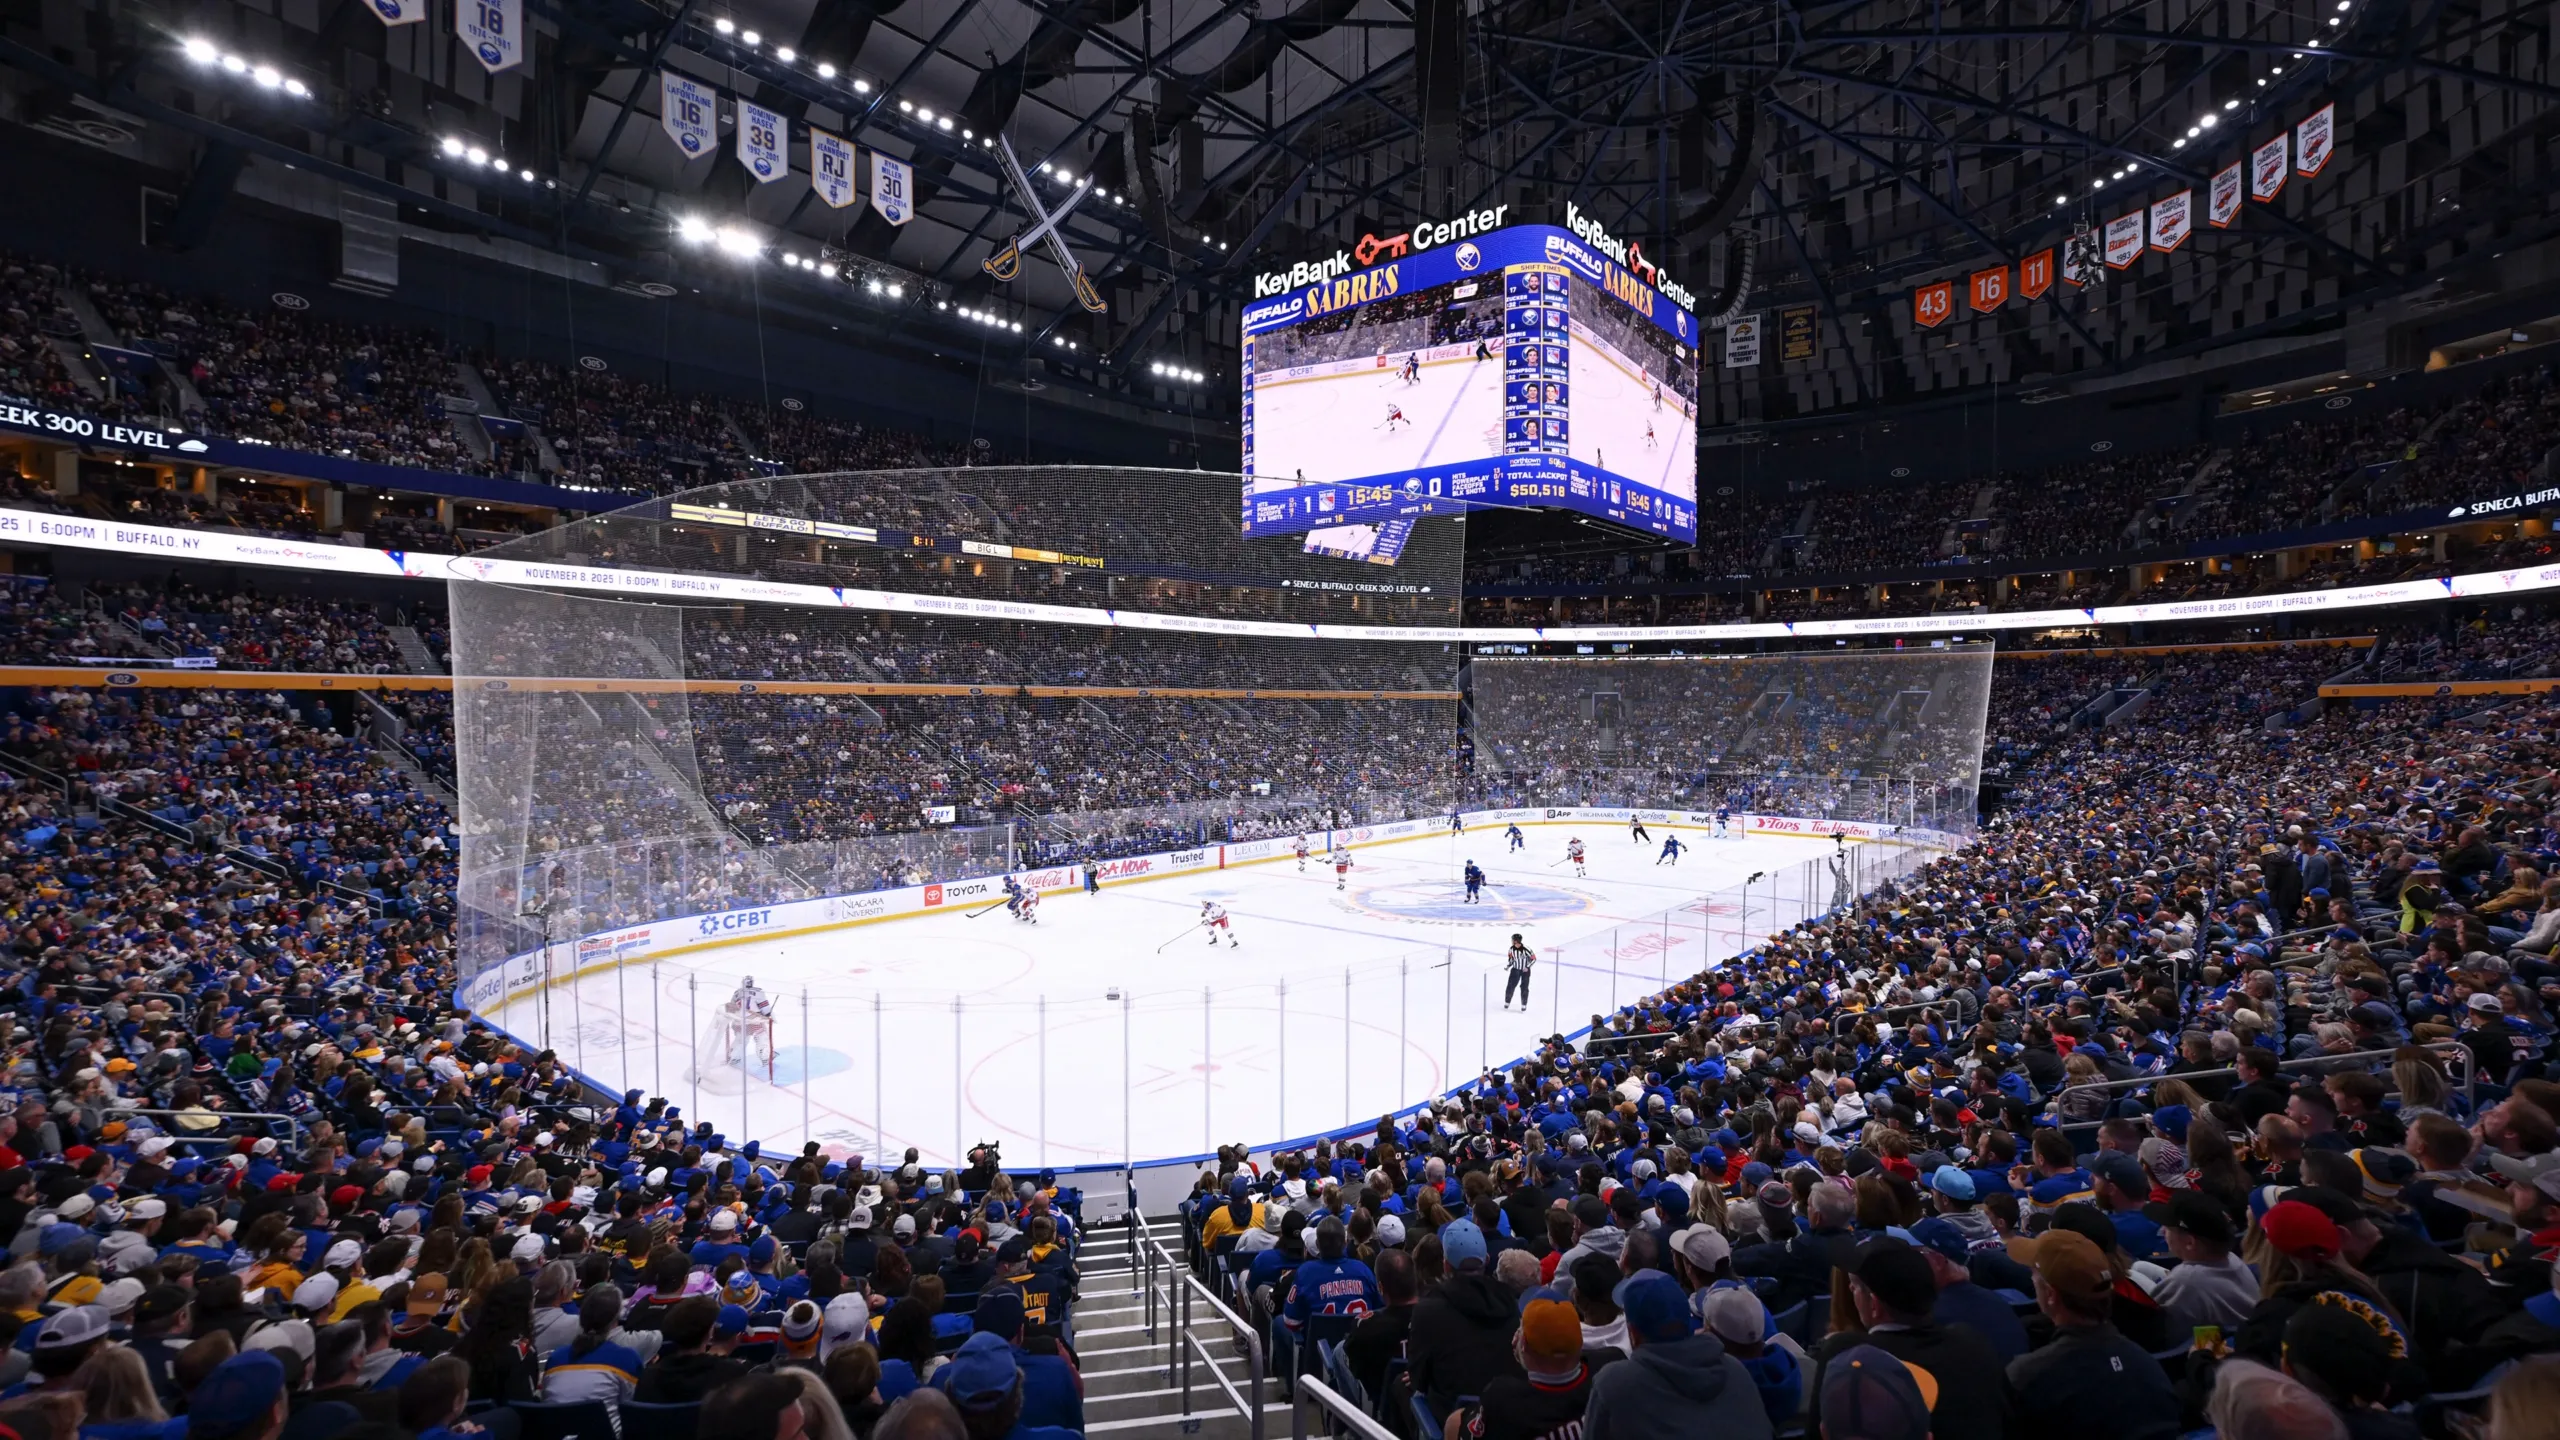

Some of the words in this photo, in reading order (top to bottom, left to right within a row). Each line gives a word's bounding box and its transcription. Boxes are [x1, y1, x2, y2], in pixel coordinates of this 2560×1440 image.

[477, 1, 503, 34] 18
[682, 81, 696, 93] PAT
[667, 84, 712, 108] LAFONTAINE
[679, 99, 701, 126] 16
[747, 105, 778, 124] DOMINIK
[751, 116, 774, 131] HASEK
[2302, 117, 2328, 139] CHAMPIONS
[2307, 114, 2323, 128] WORLD
[750, 125, 775, 151] 39
[826, 138, 840, 149] RICK
[817, 142, 850, 161] JEANNERET
[2257, 146, 2282, 166] CHAMPIONS
[2262, 142, 2278, 156] WORLD
[822, 153, 844, 178] RJ
[884, 159, 899, 171] RYAN
[2307, 155, 2321, 170] 2024
[881, 166, 902, 181] MILLER
[882, 175, 902, 199] 30
[2214, 173, 2237, 190] CHAMPIONS
[2156, 201, 2185, 217] CHAMPIONS
[2162, 197, 2179, 208] WORLD
[2110, 220, 2138, 236] CHAMPIONS
[2116, 217, 2132, 228] WORLD
[1255, 250, 1351, 298] KeyBank
[1413, 204, 1508, 250] Center
[1567, 200, 1627, 267] KeyBank
[1657, 268, 1696, 312] Center
[2116, 251, 2131, 262] 1993
[1543, 264, 1561, 272] TIMES
[2028, 259, 2044, 287] 11
[1546, 235, 1602, 274] BUFFALO
[1604, 261, 1653, 318] SABRES
[1242, 298, 1303, 327] BUFFALO
[1305, 264, 1399, 317] SABRES
[1509, 286, 1517, 294] 17
[1978, 275, 2000, 302] 16
[281, 295, 300, 307] 304
[1920, 289, 1947, 316] 43
[1730, 316, 1757, 325] BUFFALO
[1730, 335, 1755, 344] SABRES
[587, 357, 600, 368] 305
[0, 404, 41, 428] EEK
[45, 412, 94, 436] 300
[101, 424, 170, 449] LEVEL
[1452, 472, 1466, 480] HITS
[1452, 475, 1489, 485] POWERPLAY
[1507, 471, 1533, 480] TOTAL
[1536, 472, 1567, 481] JACKPOT
[1429, 477, 1441, 496] 0
[1452, 482, 1483, 491] FACEOFFS
[1465, 487, 1486, 496] SHOTS
[1510, 484, 1565, 497] $50,518
[1602, 481, 1607, 500] 1
[1347, 485, 1392, 506] 15:45
[1626, 489, 1650, 511] 15:45
[1304, 496, 1311, 513] 1
[1400, 506, 1419, 514] SHOTS
[1422, 503, 1432, 512] 14
[1665, 502, 1671, 520] 0
[2471, 496, 2522, 515] SENECA
[753, 520, 808, 532] BUFFALO!
[755, 514, 781, 524] LET'S
[792, 518, 806, 526] GO
[1315, 517, 1332, 525] SHOTS
[1, 517, 19, 531] 25
[41, 522, 95, 539] 6:00PM
[183, 537, 200, 549] NY
[914, 535, 934, 546] 8:11
[236, 545, 280, 557] KeyBank
[306, 551, 336, 561] Center
[977, 544, 991, 553] BIG
[993, 545, 998, 554] L
[1063, 555, 1080, 563] HUNT
[1083, 558, 1100, 566] HUNT
[525, 568, 577, 581] NOVEMBER
[591, 572, 614, 584] 2025
[626, 575, 660, 588] 6:00PM
[709, 583, 720, 592] NY
[1293, 580, 1320, 590] SENECA
[1321, 582, 1353, 591] BUFFALO
[1355, 584, 1378, 592] CREEK
[1379, 585, 1393, 593] 300
[1395, 584, 1418, 593] LEVEL
[914, 599, 946, 609] NOVEMBER
[954, 601, 969, 610] 2025
[2170, 604, 2207, 616] NOVEMBER
[2218, 603, 2237, 612] 2025
[2246, 600, 2273, 610] 6:00PM
[2318, 595, 2327, 603] NY
[1854, 621, 1885, 630] NOVEMBER
[1893, 620, 1909, 628] 2025
[1916, 619, 1939, 628] 6:00PM
[1977, 617, 1986, 625] NY
[114, 674, 130, 683] 102
[1637, 810, 1667, 821] Surfside
[1811, 820, 1830, 833] Tim
[1831, 822, 1870, 836] Hortons
[1171, 849, 1204, 864] Trusted
[1234, 842, 1270, 856] LECOM
[1120, 858, 1152, 873] NOVA
[947, 884, 987, 897] TOYOTA
[842, 897, 885, 910] NIAGARA
[723, 910, 771, 929] CFBT
[842, 907, 885, 920] UNIVERSITY
[1320, 1279, 1363, 1299] PANARIN
